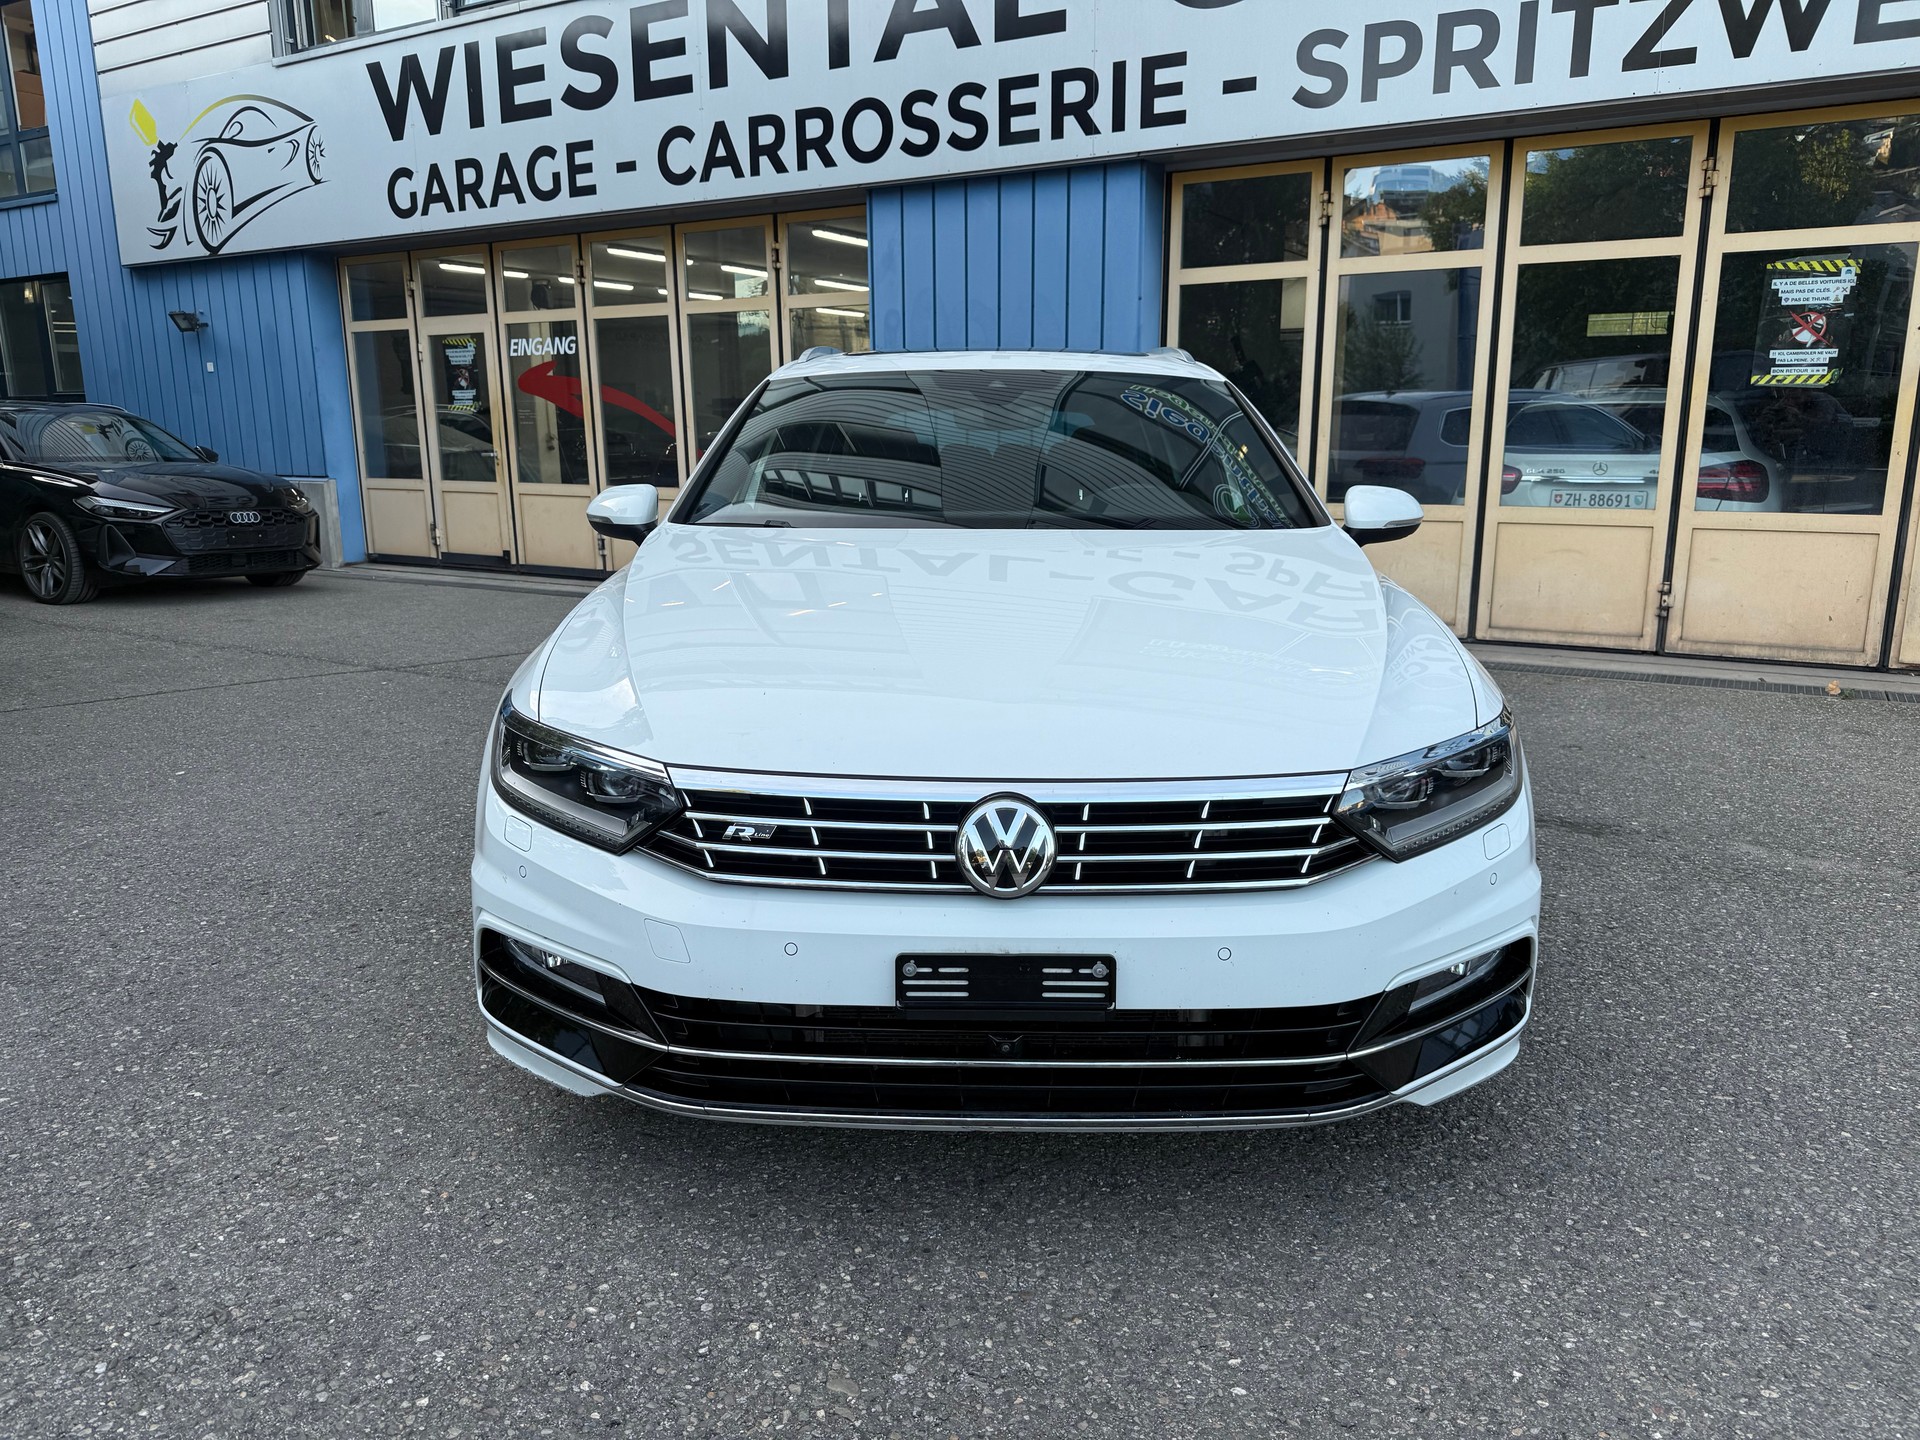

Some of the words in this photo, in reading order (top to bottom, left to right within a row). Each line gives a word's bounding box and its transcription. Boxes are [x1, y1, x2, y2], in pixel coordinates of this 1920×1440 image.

[387, 139, 597, 219] GARAGE
[657, 51, 1188, 185] CARROSSERIE
[510, 336, 577, 357] EINGANG
